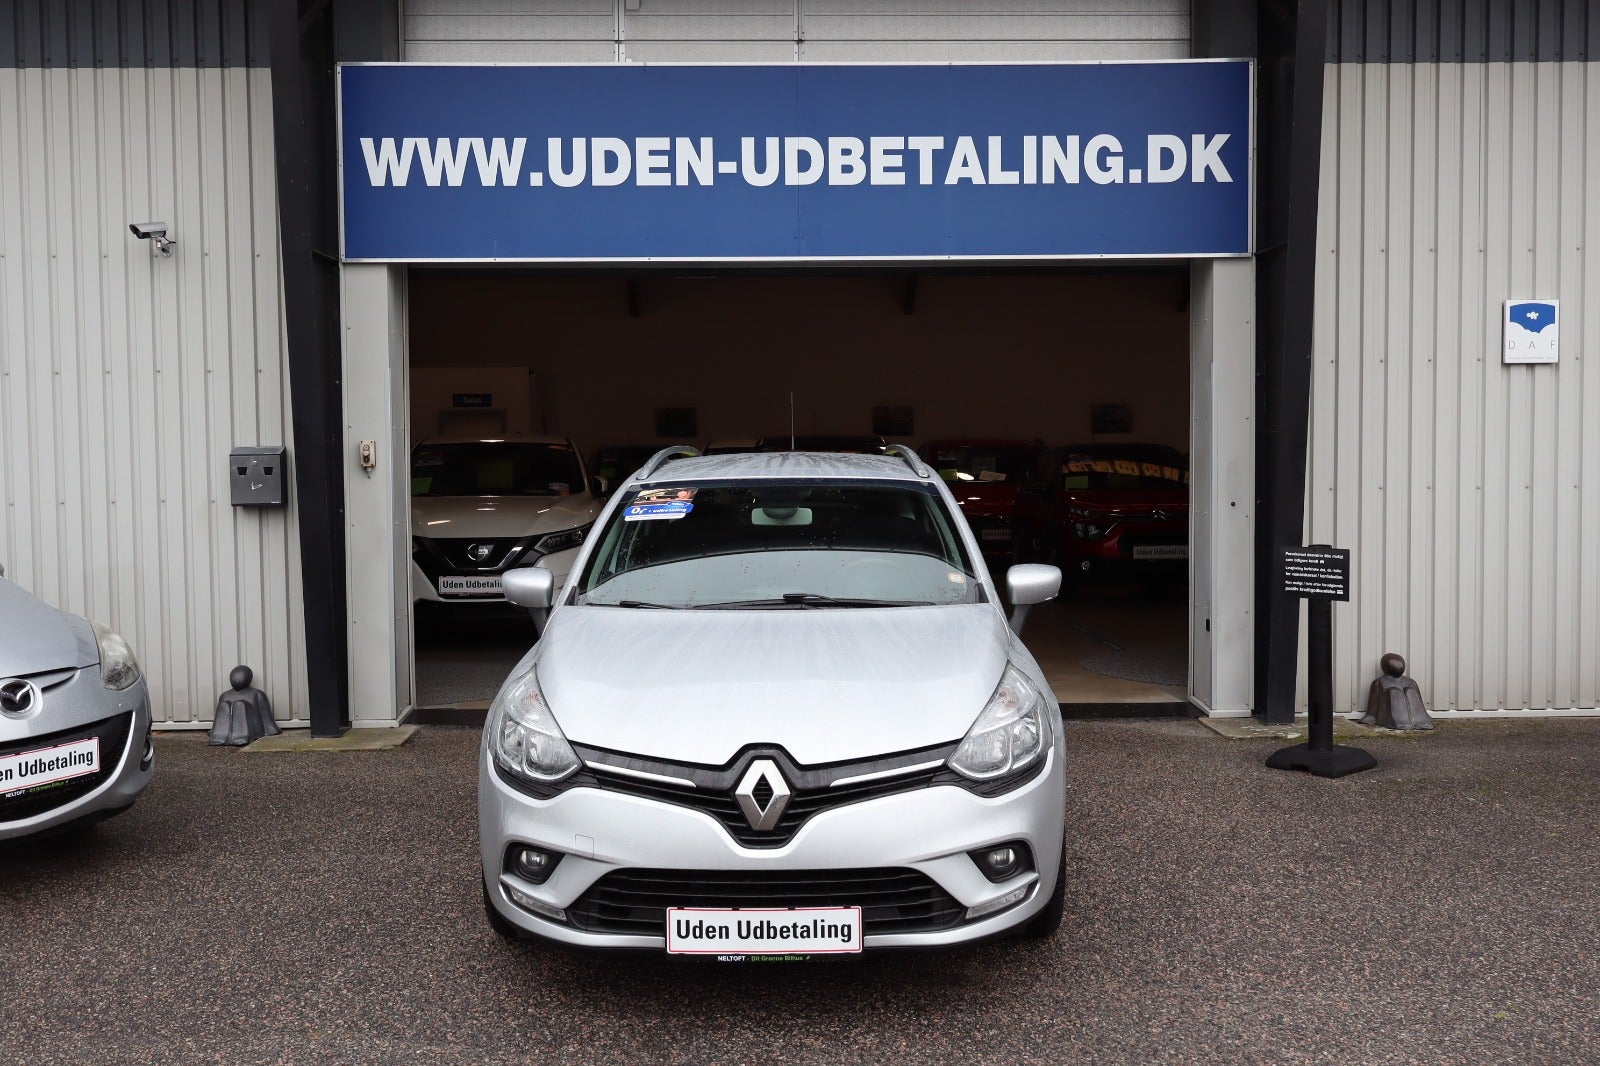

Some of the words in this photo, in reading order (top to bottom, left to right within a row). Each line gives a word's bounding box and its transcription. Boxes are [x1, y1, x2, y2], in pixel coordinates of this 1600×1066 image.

[360, 134, 1234, 187] WWW.UDEN-UDBETALING.DK
[442, 580, 464, 589] Uden
[18, 750, 94, 778] Udbetaling
[676, 919, 730, 939] Uden
[737, 919, 852, 943] Udbetaling
